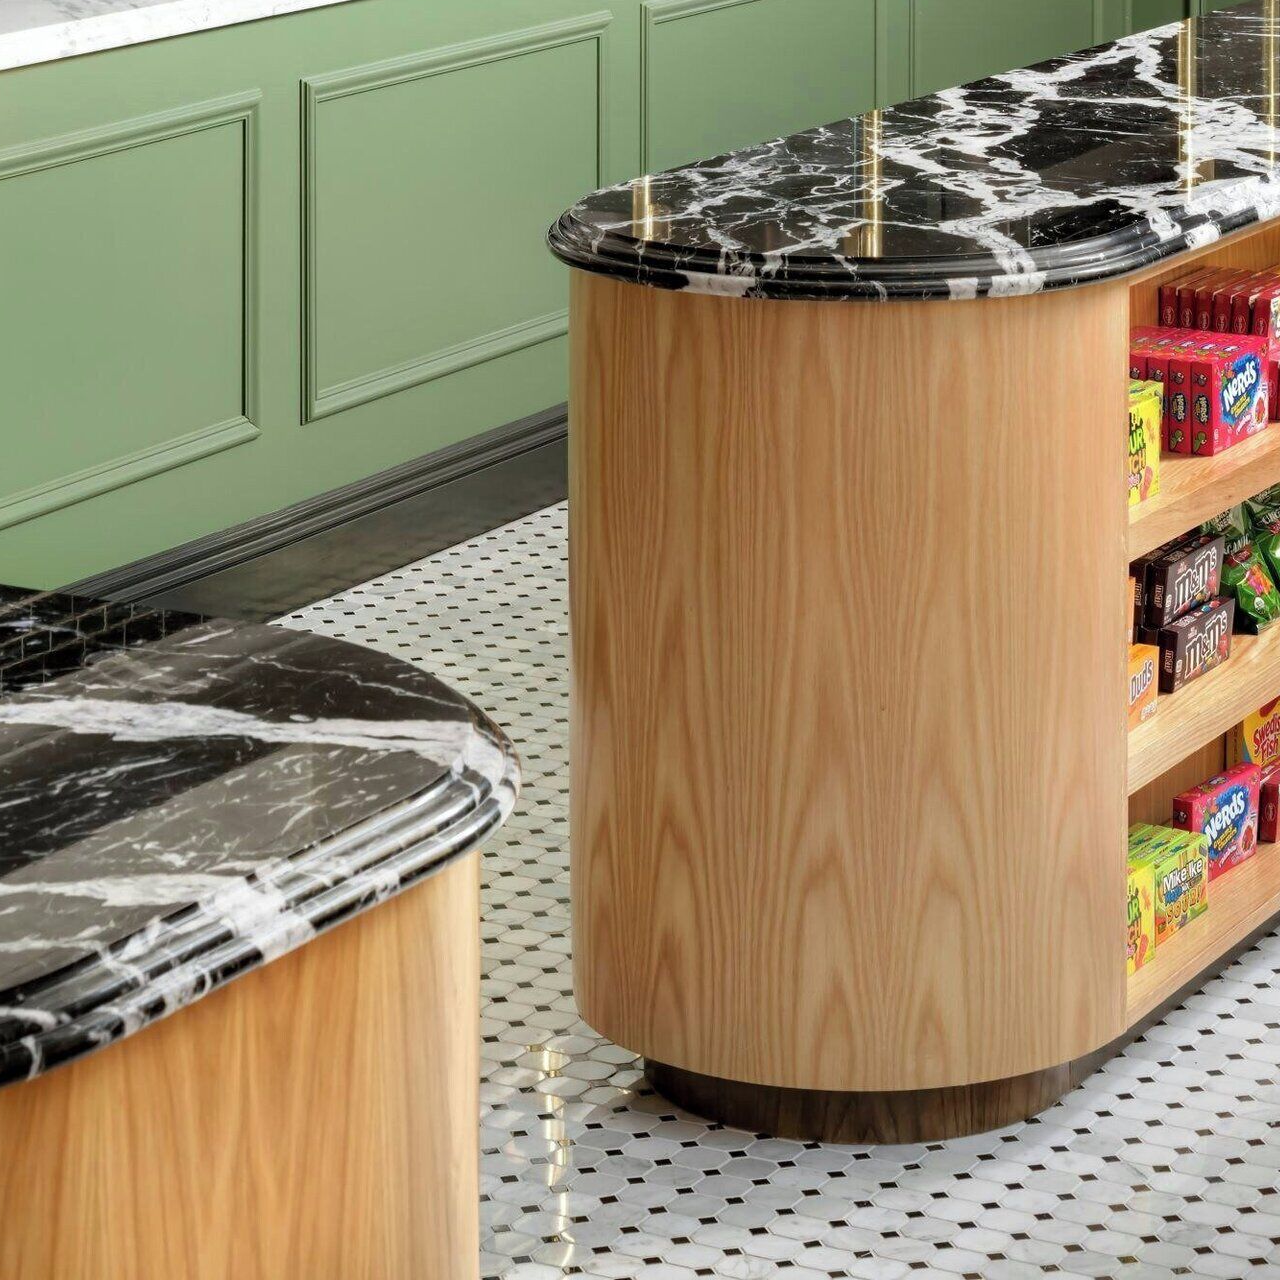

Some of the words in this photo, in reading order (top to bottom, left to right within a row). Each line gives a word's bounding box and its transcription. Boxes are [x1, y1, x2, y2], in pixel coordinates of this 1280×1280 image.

[1130, 429, 1144, 454] UR
[1260, 735, 1280, 767] Fish
[1163, 865, 1187, 892] Mike
[1189, 858, 1203, 878] Ike
[1128, 897, 1140, 927] UR
